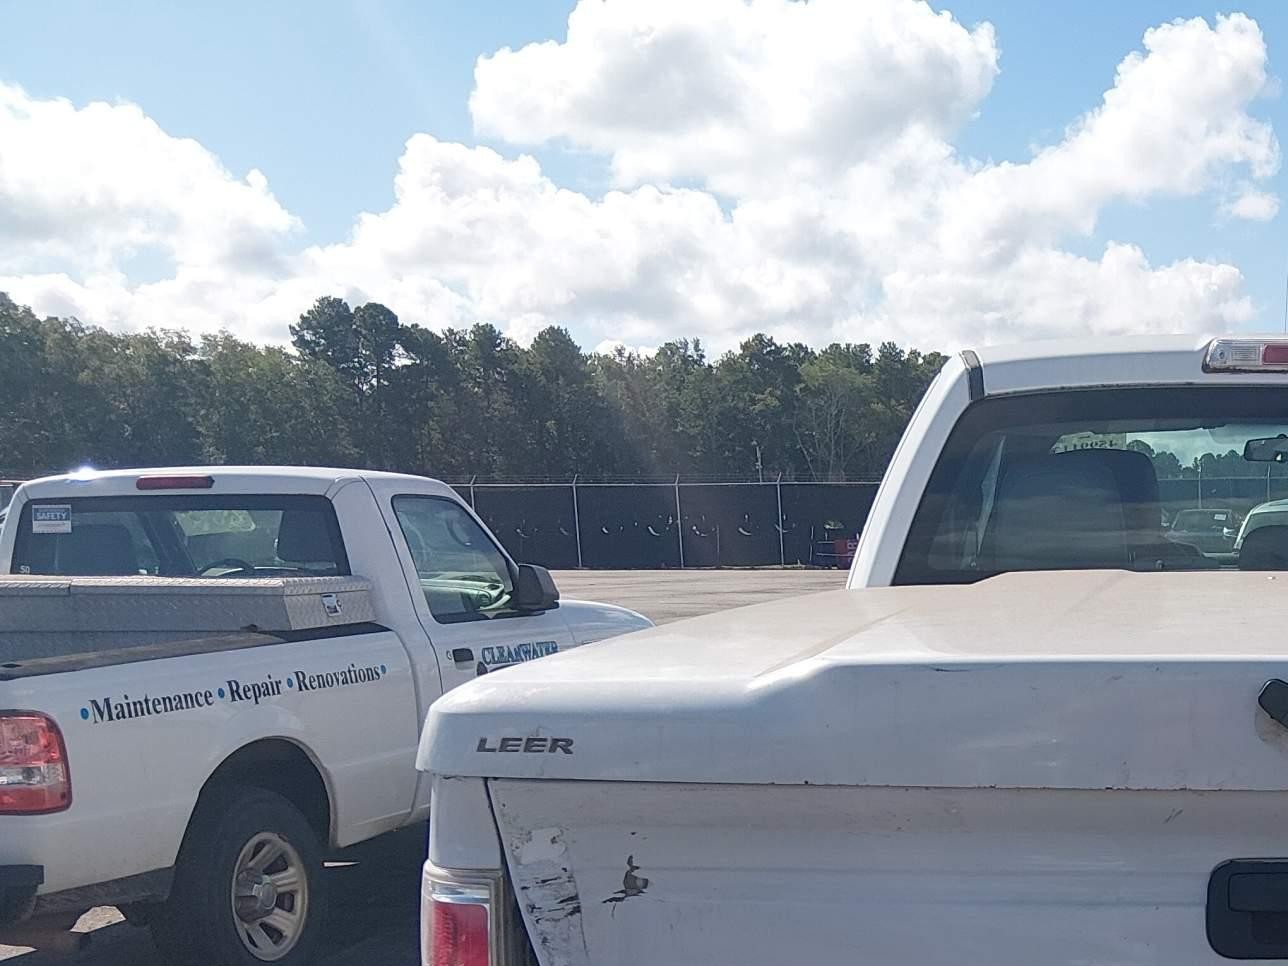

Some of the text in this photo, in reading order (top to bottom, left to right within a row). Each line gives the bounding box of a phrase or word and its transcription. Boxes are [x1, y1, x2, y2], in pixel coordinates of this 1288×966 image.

[36, 512, 67, 520] SAFETY
[89, 663, 381, 724] Maintenance Repair Renovations
[476, 737, 575, 755] LEER
